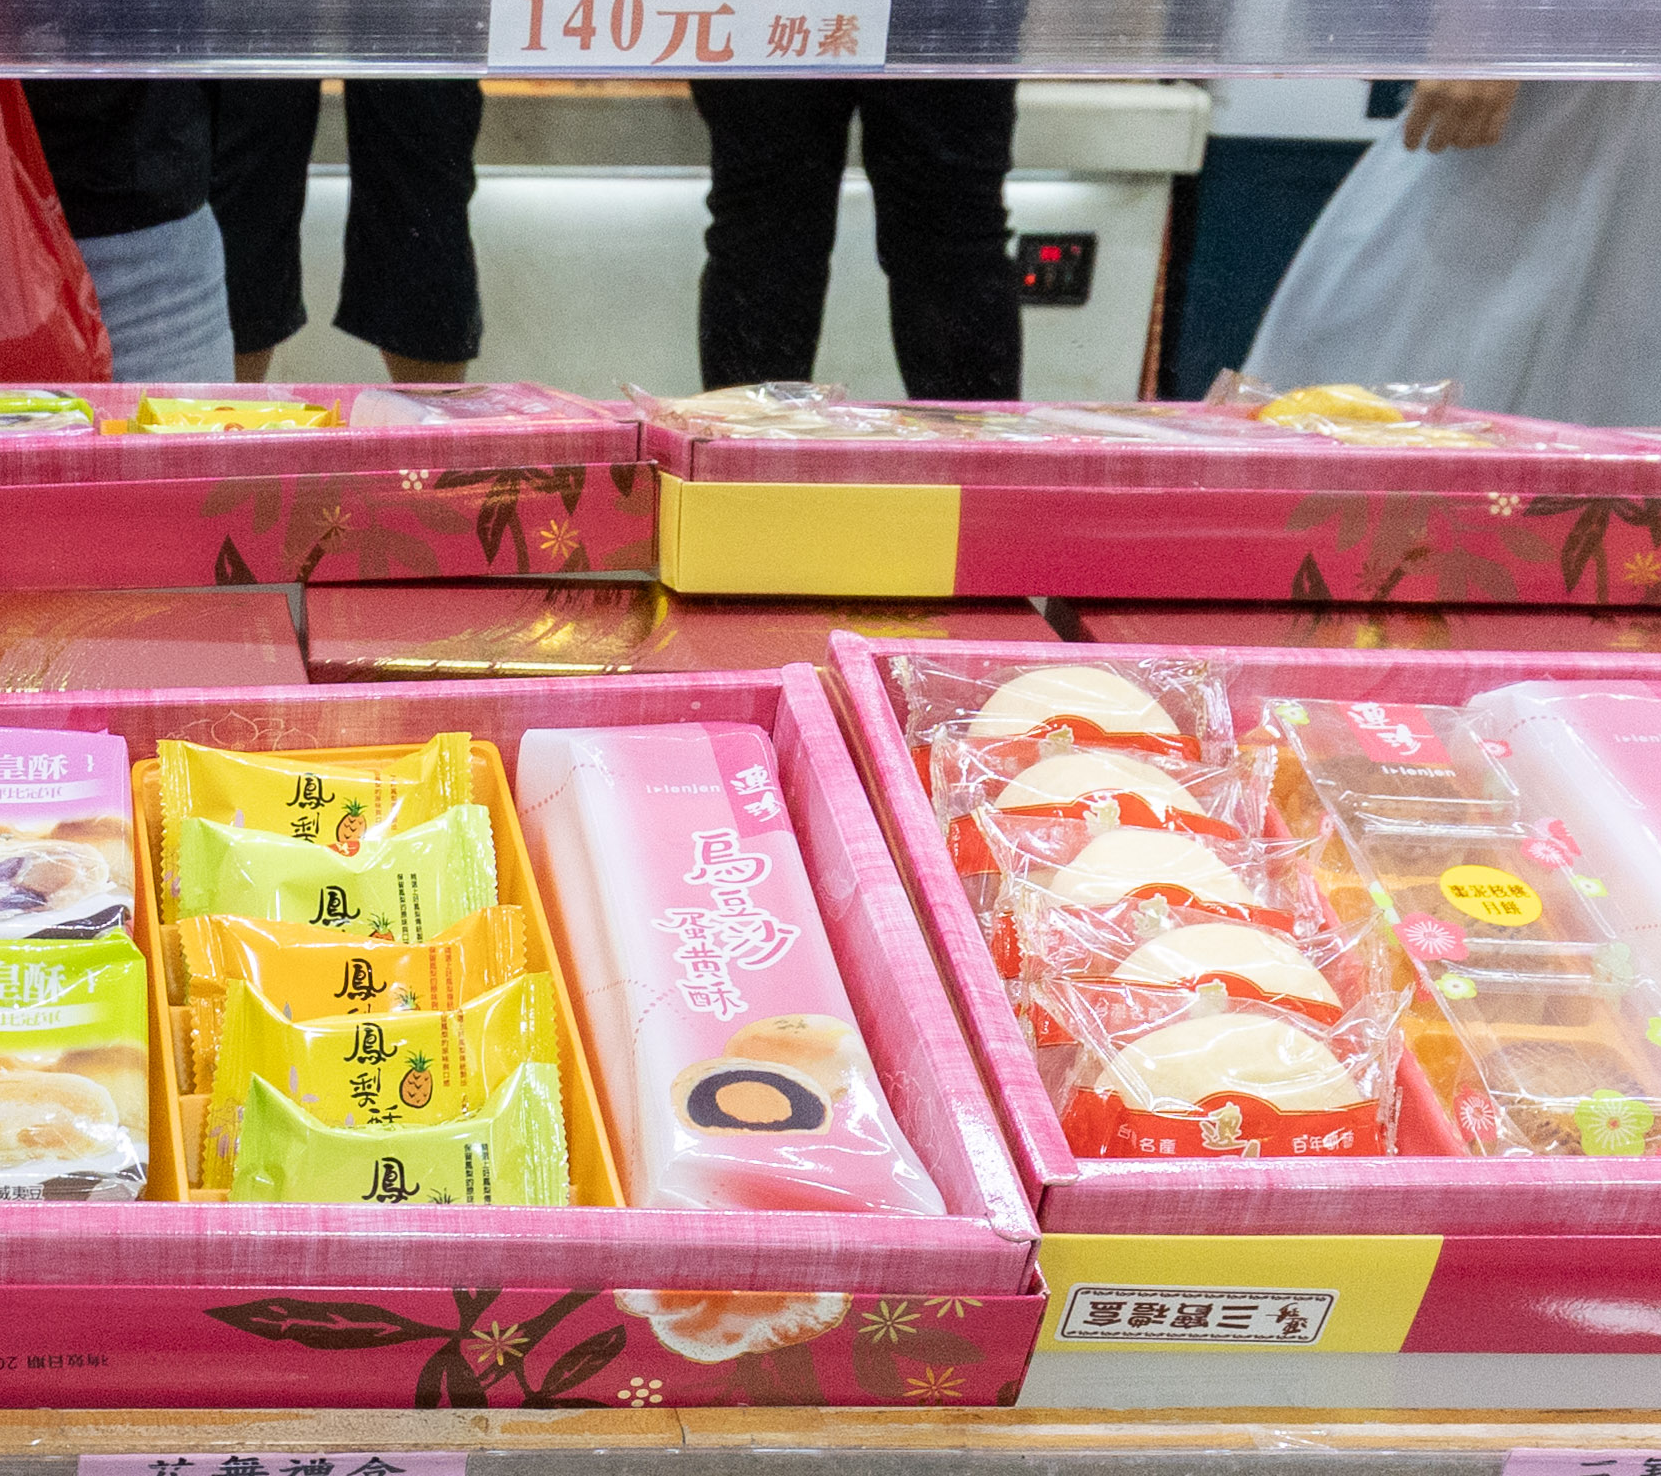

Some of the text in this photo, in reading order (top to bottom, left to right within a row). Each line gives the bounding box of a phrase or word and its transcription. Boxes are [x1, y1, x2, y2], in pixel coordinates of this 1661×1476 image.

[766, 14, 861, 59] 奶素
[729, 763, 780, 820] 連珍
[653, 907, 750, 1019] 蛋黃酥
[1083, 1300, 1259, 1331] 三寶禮盒
